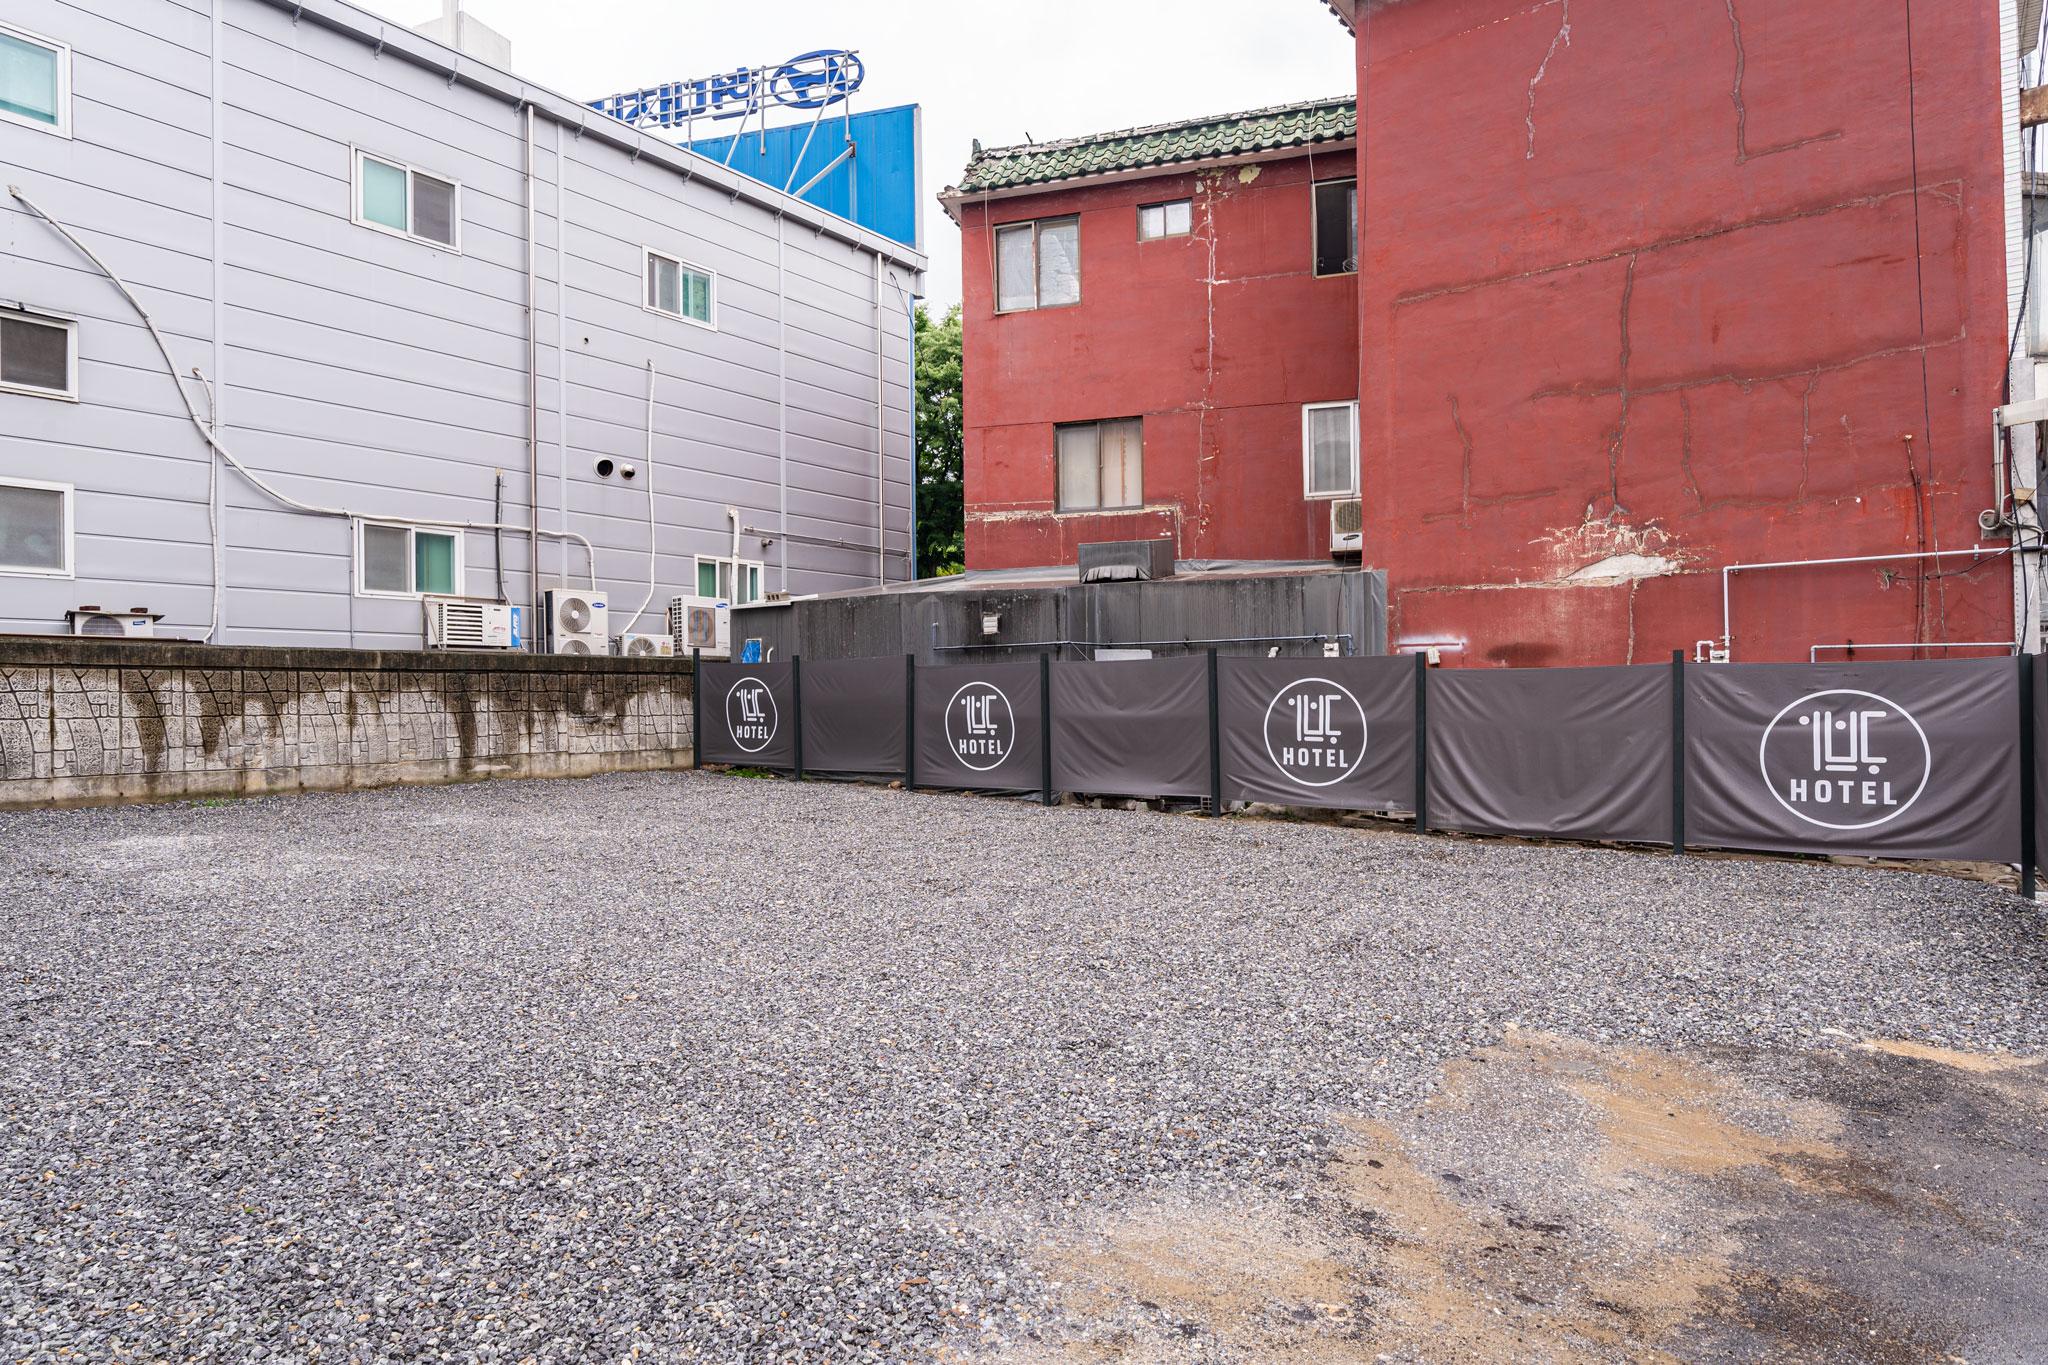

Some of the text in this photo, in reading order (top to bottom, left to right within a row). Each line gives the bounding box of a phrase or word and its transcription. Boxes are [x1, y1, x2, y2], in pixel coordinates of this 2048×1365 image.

[736, 726, 768, 739] HOTEL
[959, 739, 1003, 755] HOTEL
[1282, 747, 1348, 768] HOTEL
[1790, 778, 1898, 806] HOTEL
